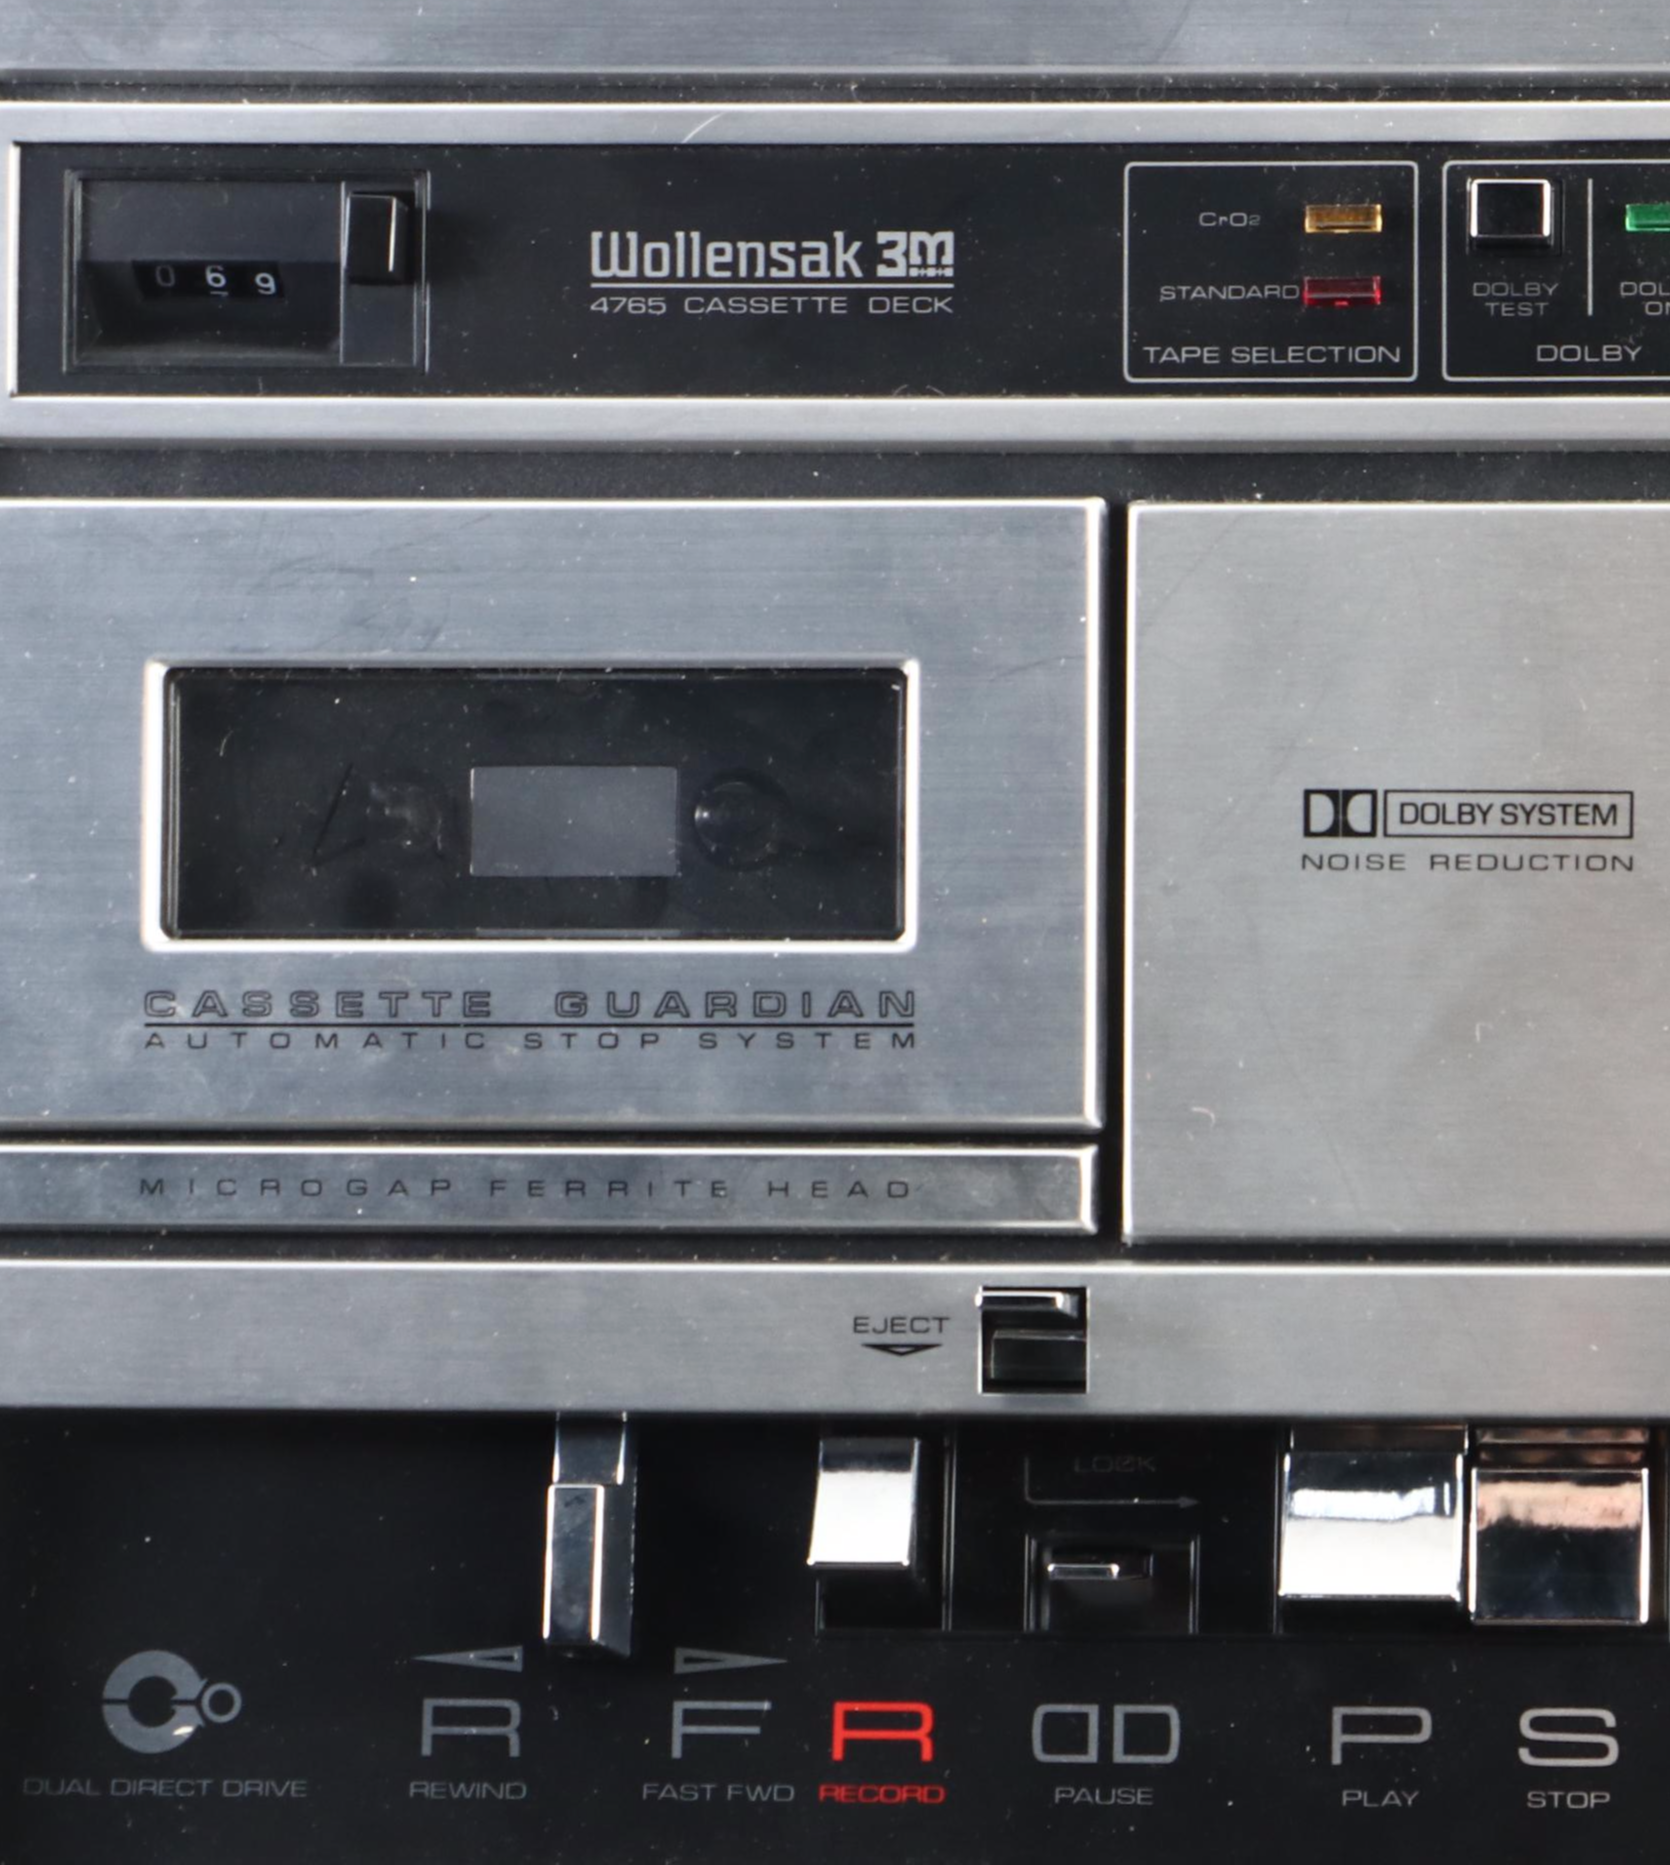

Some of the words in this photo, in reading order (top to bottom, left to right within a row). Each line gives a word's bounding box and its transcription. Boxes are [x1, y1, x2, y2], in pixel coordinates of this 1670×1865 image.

[590, 231, 863, 278] Wollensak
[876, 231, 954, 277] 3M
[1159, 284, 1300, 300] STANDARD
[1472, 282, 1559, 298] DOLBY
[590, 297, 667, 315] 4765
[684, 297, 848, 314] CASSETTE
[868, 297, 954, 314] DECK
[1485, 301, 1549, 317] TEST
[1143, 345, 1222, 364] TAPE
[1230, 345, 1401, 364] SELECTION
[1536, 344, 1644, 363] DOLBY
[1399, 803, 1493, 825] DOLBY
[1500, 803, 1618, 826] SYSTEM
[1301, 854, 1406, 871] NOISE
[1429, 854, 1634, 871] REDUCTION
[144, 990, 492, 1018] CASSETTE
[554, 990, 915, 1018] GUARDIAN
[144, 1033, 485, 1050] AUTOMATIC
[524, 1032, 660, 1050] STOP
[698, 1032, 915, 1050] SYSTEM
[138, 1179, 451, 1198] MICROGAP
[489, 1179, 728, 1198] FERRITE
[767, 1179, 911, 1197] HEAD
[853, 1317, 950, 1334] EJECT
[421, 1698, 523, 1757] R
[670, 1699, 772, 1759] F
[831, 1701, 934, 1762] R
[1330, 1706, 1432, 1766] P
[1518, 1707, 1619, 1768] S
[23, 1778, 101, 1796] DUAL
[111, 1779, 211, 1796] DIRECT
[222, 1780, 308, 1797] DRIVE
[409, 1781, 527, 1799] REWIND
[643, 1783, 716, 1801] FAST
[726, 1784, 795, 1802] FWD
[819, 1784, 945, 1804] RECORD
[1054, 1787, 1153, 1805] PAUSE
[1342, 1789, 1419, 1807] PLAY
[1527, 1791, 1611, 1809] STOP
